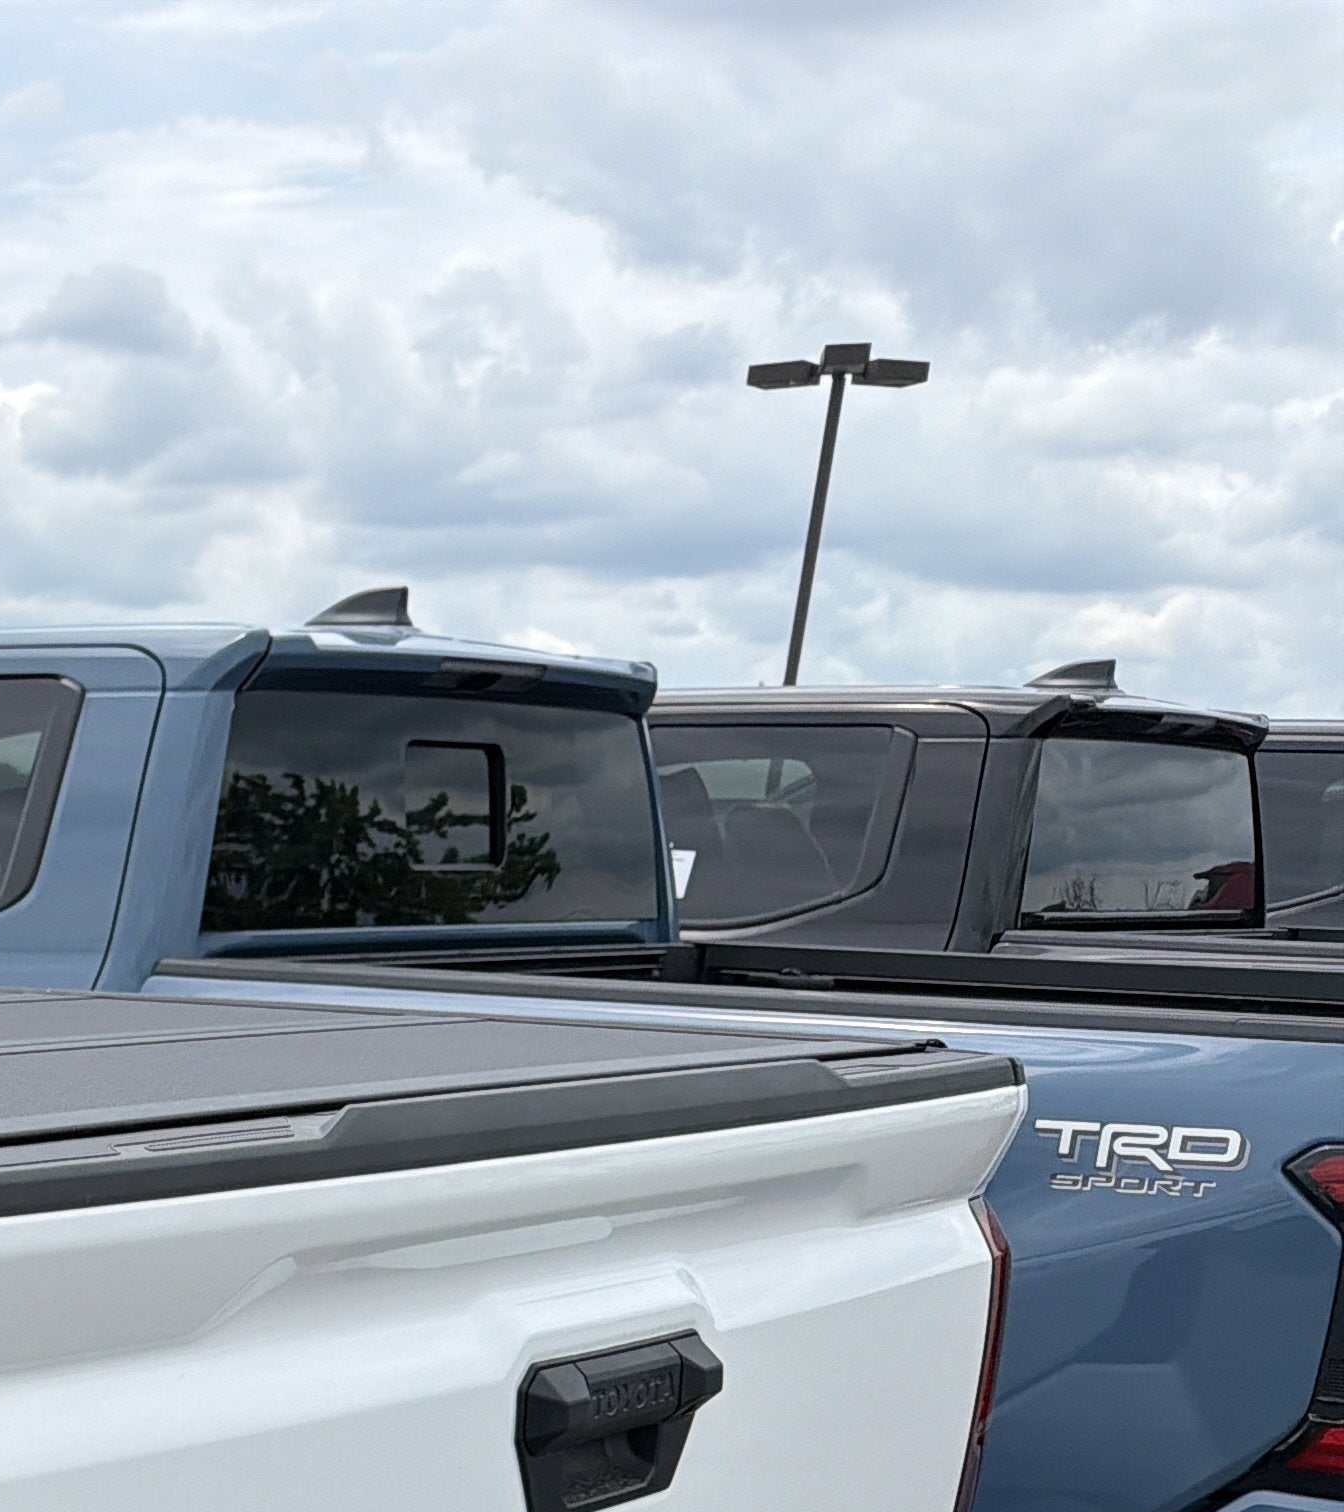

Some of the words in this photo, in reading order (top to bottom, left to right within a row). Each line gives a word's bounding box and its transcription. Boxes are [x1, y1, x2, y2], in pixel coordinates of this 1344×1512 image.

[1034, 1118, 1251, 1177] TRD
[1049, 1173, 1217, 1198] SPORT
[591, 1371, 676, 1420] TOYOTA
